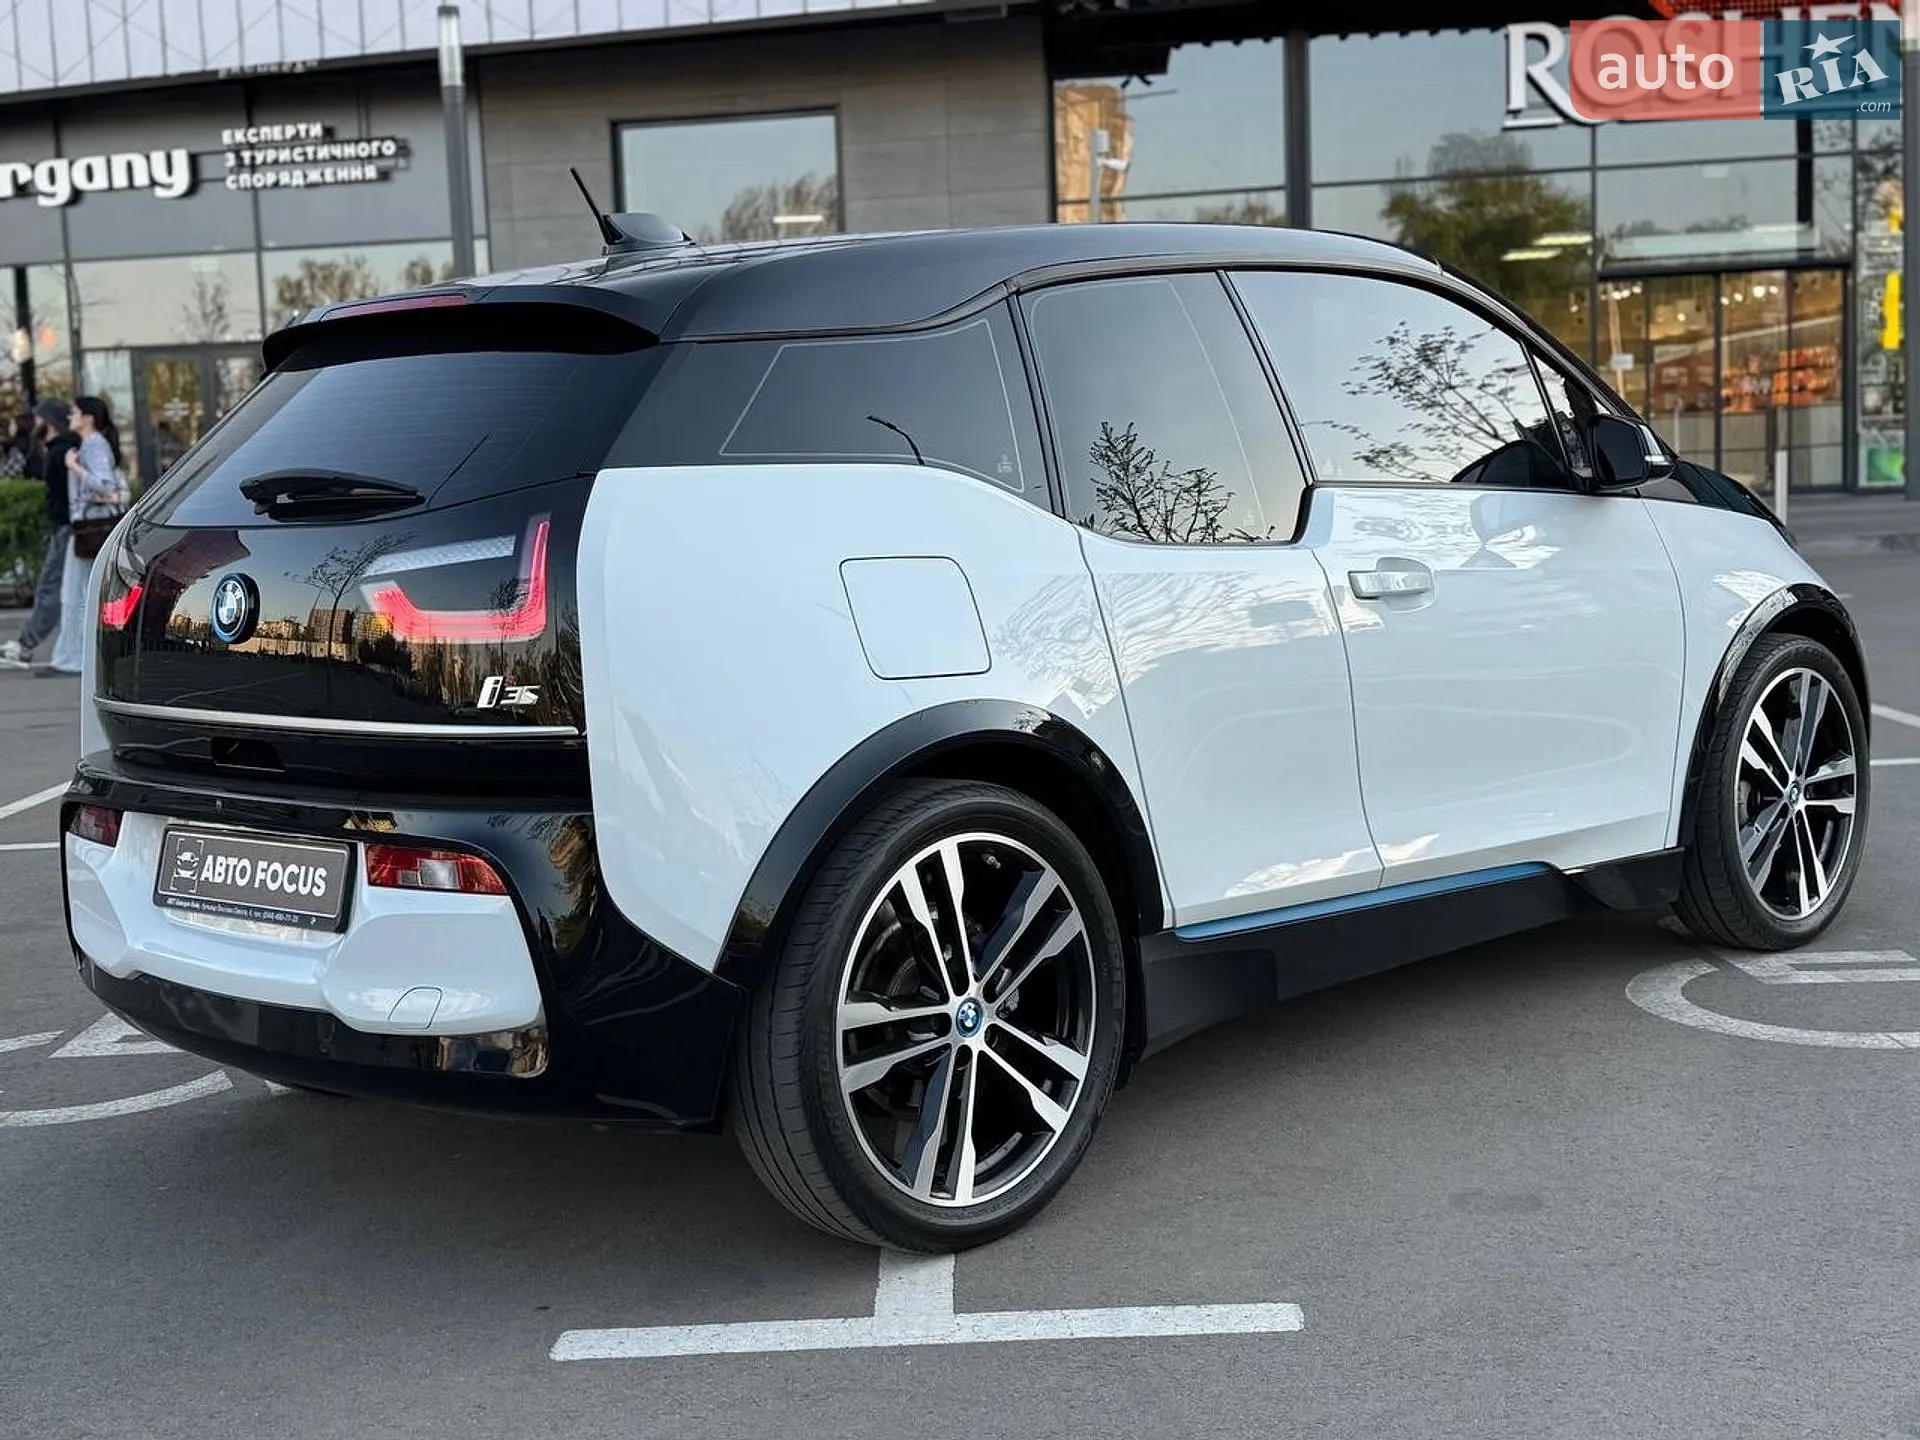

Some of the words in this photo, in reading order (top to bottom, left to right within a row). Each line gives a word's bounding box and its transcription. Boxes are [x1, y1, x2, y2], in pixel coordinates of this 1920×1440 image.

[221, 122, 323, 145] ЕКСПЕРТИ
[240, 139, 397, 165] ТУРИСТИЧНОГО
[225, 164, 378, 189] СПОРЯДЖЕННЯ
[254, 861, 328, 897] FOCUS
